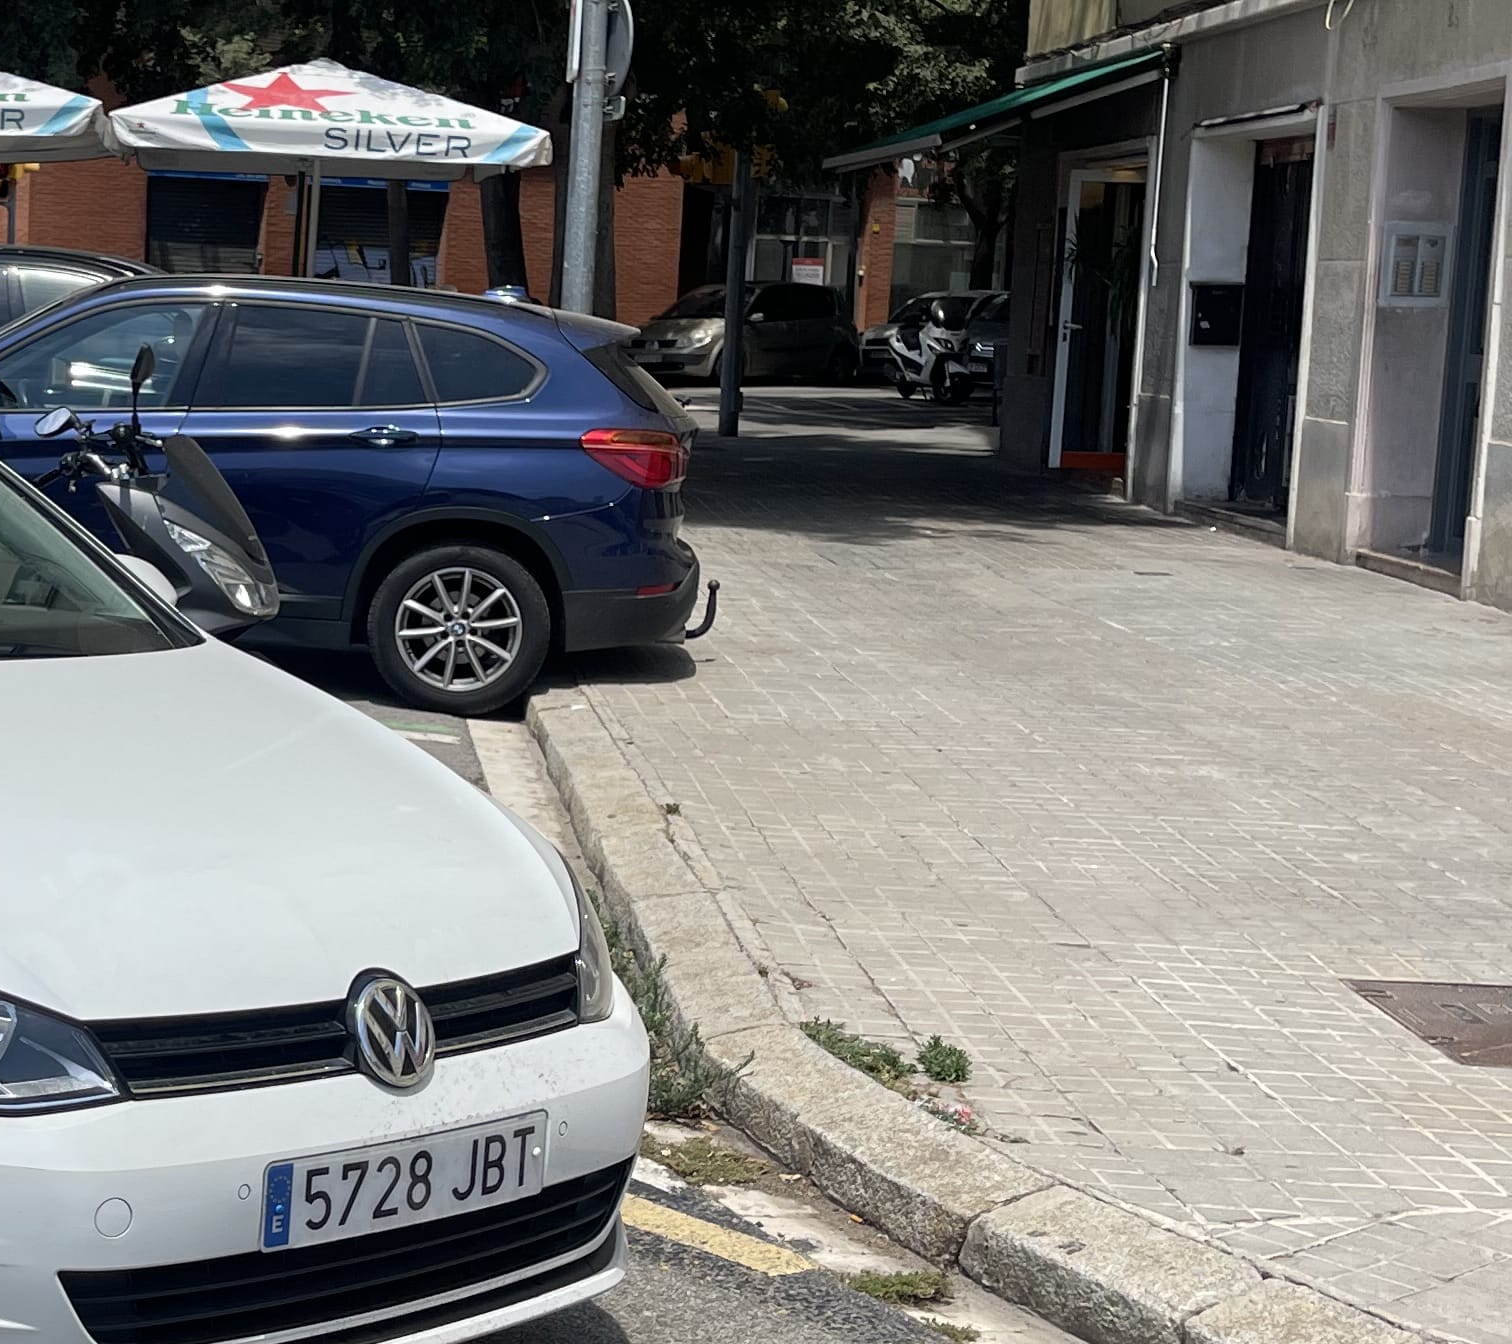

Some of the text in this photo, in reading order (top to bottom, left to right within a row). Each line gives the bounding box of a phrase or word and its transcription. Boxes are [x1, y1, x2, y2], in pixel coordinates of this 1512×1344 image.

[172, 99, 475, 128] Heineken
[324, 127, 472, 158] SILVER
[271, 1125, 535, 1234] E 5728 JBT
